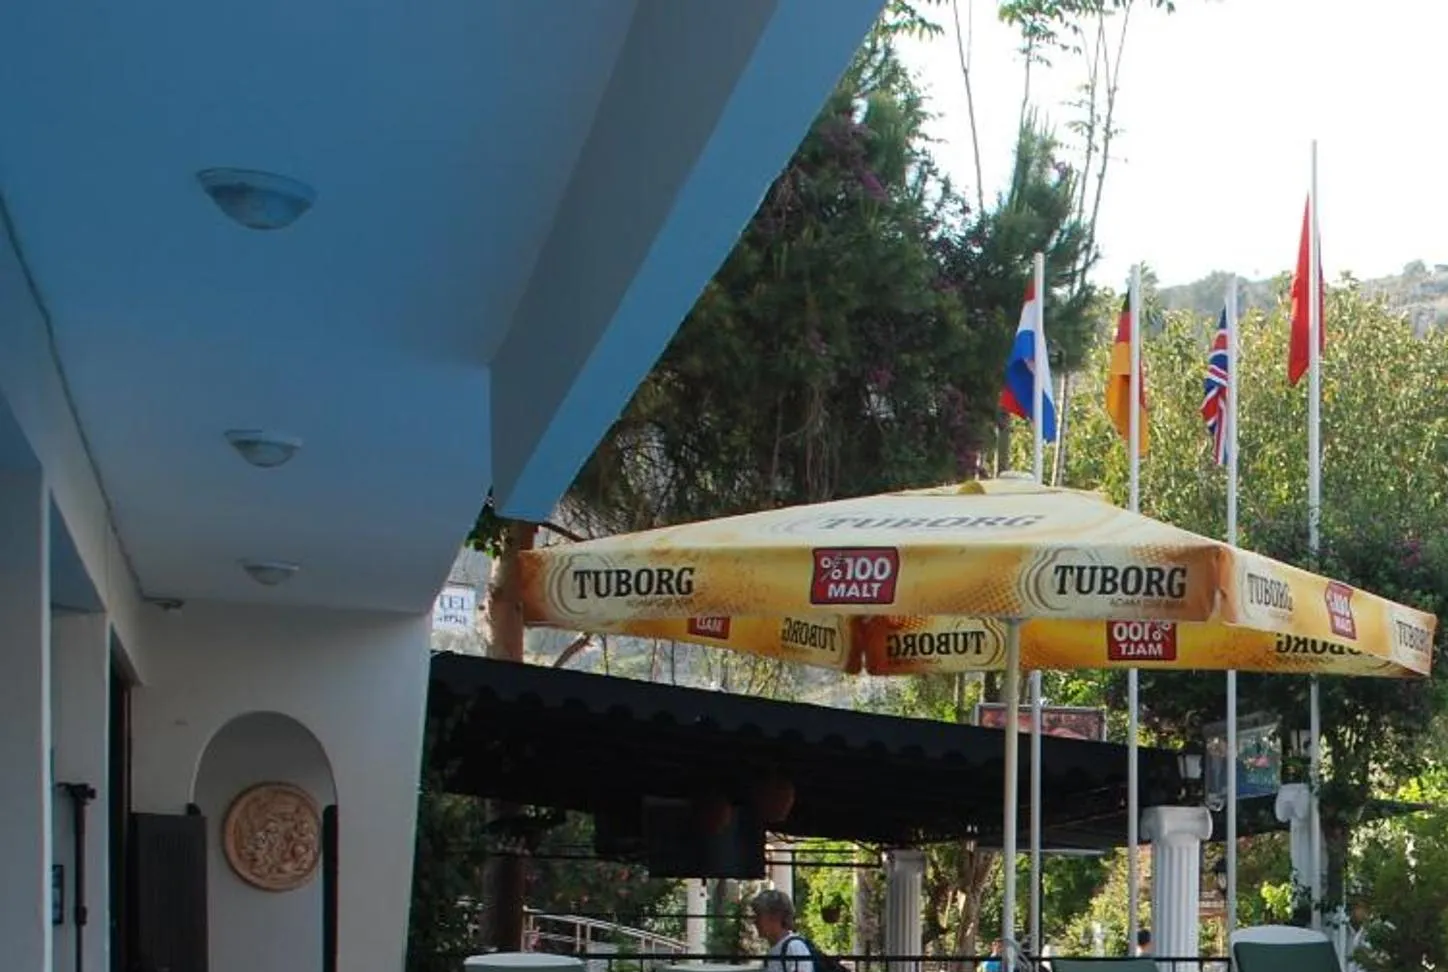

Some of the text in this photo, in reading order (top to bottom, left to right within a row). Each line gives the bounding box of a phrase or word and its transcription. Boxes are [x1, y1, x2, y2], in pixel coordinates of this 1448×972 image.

[573, 567, 695, 599] TUBORG
[828, 583, 882, 598] MALT
[1054, 565, 1187, 598] TUBORG
[1247, 573, 1293, 612] TUBORG
